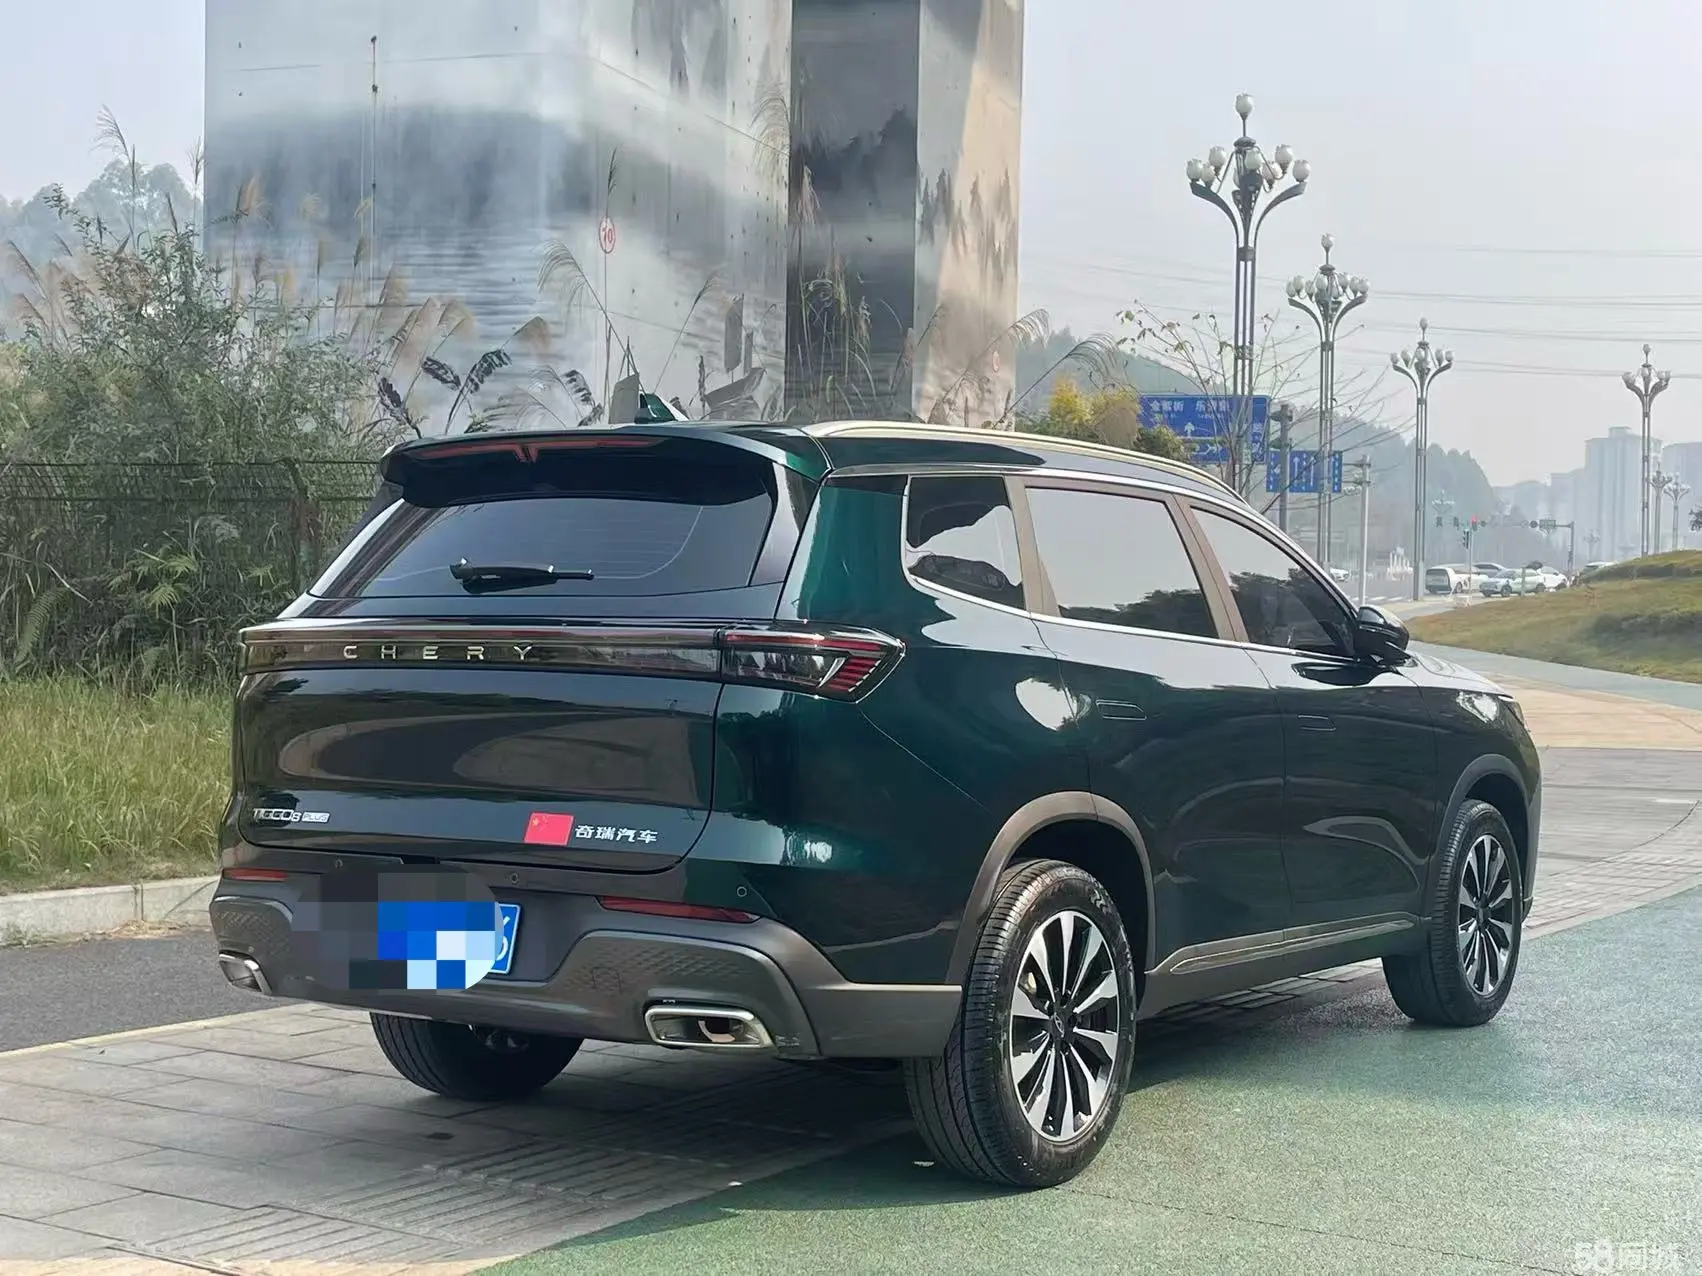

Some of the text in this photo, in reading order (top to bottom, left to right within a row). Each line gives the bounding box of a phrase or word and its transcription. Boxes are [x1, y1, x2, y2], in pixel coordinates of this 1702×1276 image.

[343, 644, 532, 661] CHERY
[575, 824, 659, 844] 奇瑞汽车
